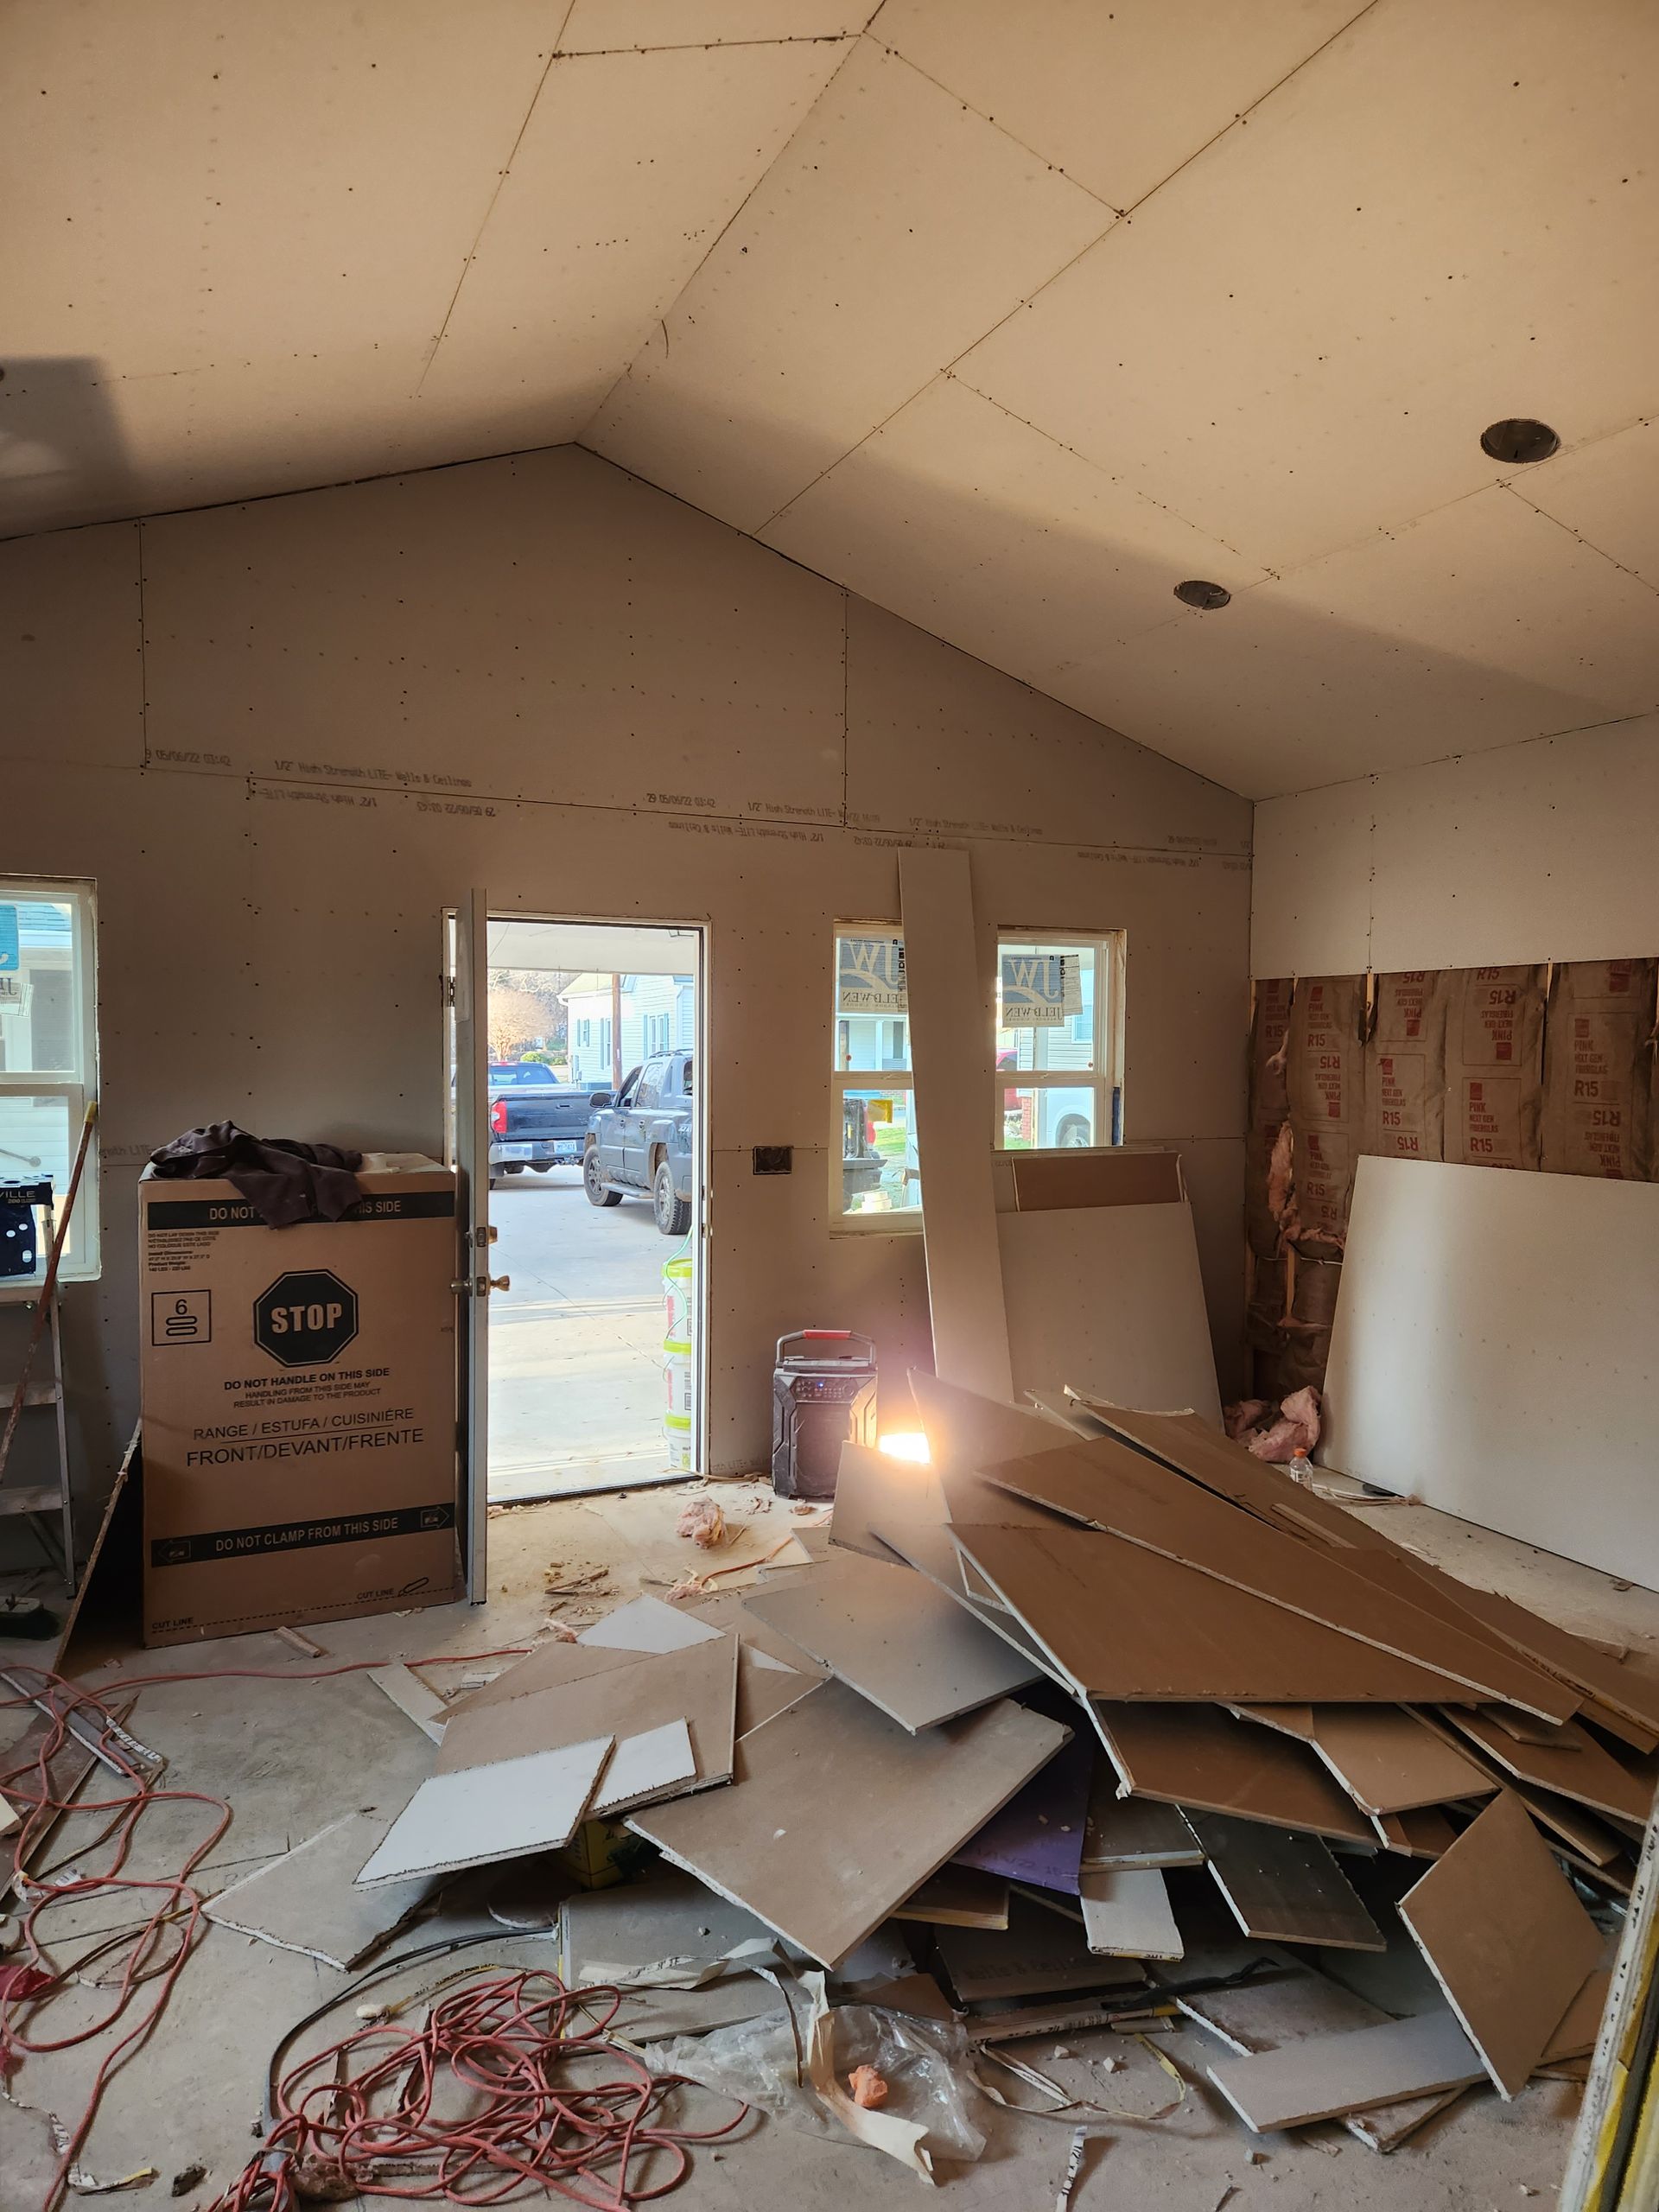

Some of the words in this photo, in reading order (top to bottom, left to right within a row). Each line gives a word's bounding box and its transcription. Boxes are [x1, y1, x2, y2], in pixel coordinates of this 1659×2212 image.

[1489, 988, 1516, 1005] R15
[1265, 1025, 1283, 1038] R15
[1492, 1030, 1512, 1041] PINK
[1308, 1033, 1325, 1047] R15
[1320, 1056, 1341, 1069] R15
[1325, 1090, 1341, 1101] PINK
[1574, 1080, 1599, 1097] R15
[1469, 1102, 1486, 1113] PINK
[1382, 1110, 1401, 1125] R15
[1593, 1109, 1620, 1127] R15
[1397, 1136, 1419, 1151] R15
[1471, 1137, 1493, 1153] R15
[1600, 1154, 1621, 1167] PINK
[1306, 1182, 1325, 1196] R15
[209, 1208, 228, 1220] DO
[231, 1206, 256, 1219] NOT
[375, 1200, 401, 1213] SIDE
[175, 1299, 188, 1315] 6
[271, 1303, 342, 1334] STOP
[225, 1381, 241, 1390] DO
[244, 1379, 268, 1389] NOT
[271, 1374, 316, 1386] HANDLE
[320, 1372, 336, 1382] ON
[339, 1370, 363, 1381] THIS
[365, 1368, 390, 1377] SIDE
[245, 1389, 287, 1399] HANDLING
[289, 1387, 313, 1396] FROM
[354, 1381, 370, 1389] MAY
[233, 1400, 265, 1408] RESULT
[276, 1395, 311, 1405] DAMAGE
[327, 1391, 341, 1400] THE
[343, 1389, 381, 1398] PRODUCT
[194, 1424, 249, 1441] RANGE
[252, 1424, 257, 1436] /
[262, 1417, 320, 1434] ESTUFA
[323, 1416, 328, 1428] /
[187, 1428, 424, 1467] FRONT/DEVANT/FRENTE
[216, 1539, 233, 1552] DO
[237, 1535, 261, 1548] NOT
[264, 1529, 305, 1546] CLAMP
[308, 1524, 341, 1540] FROM
[344, 1521, 370, 1535] THIS
[372, 1517, 399, 1531] SIDE
[357, 1592, 373, 1600] CUT
[376, 1588, 394, 1597] LINE
[152, 1619, 171, 1630] CUT
[173, 1617, 194, 1627] LINE
